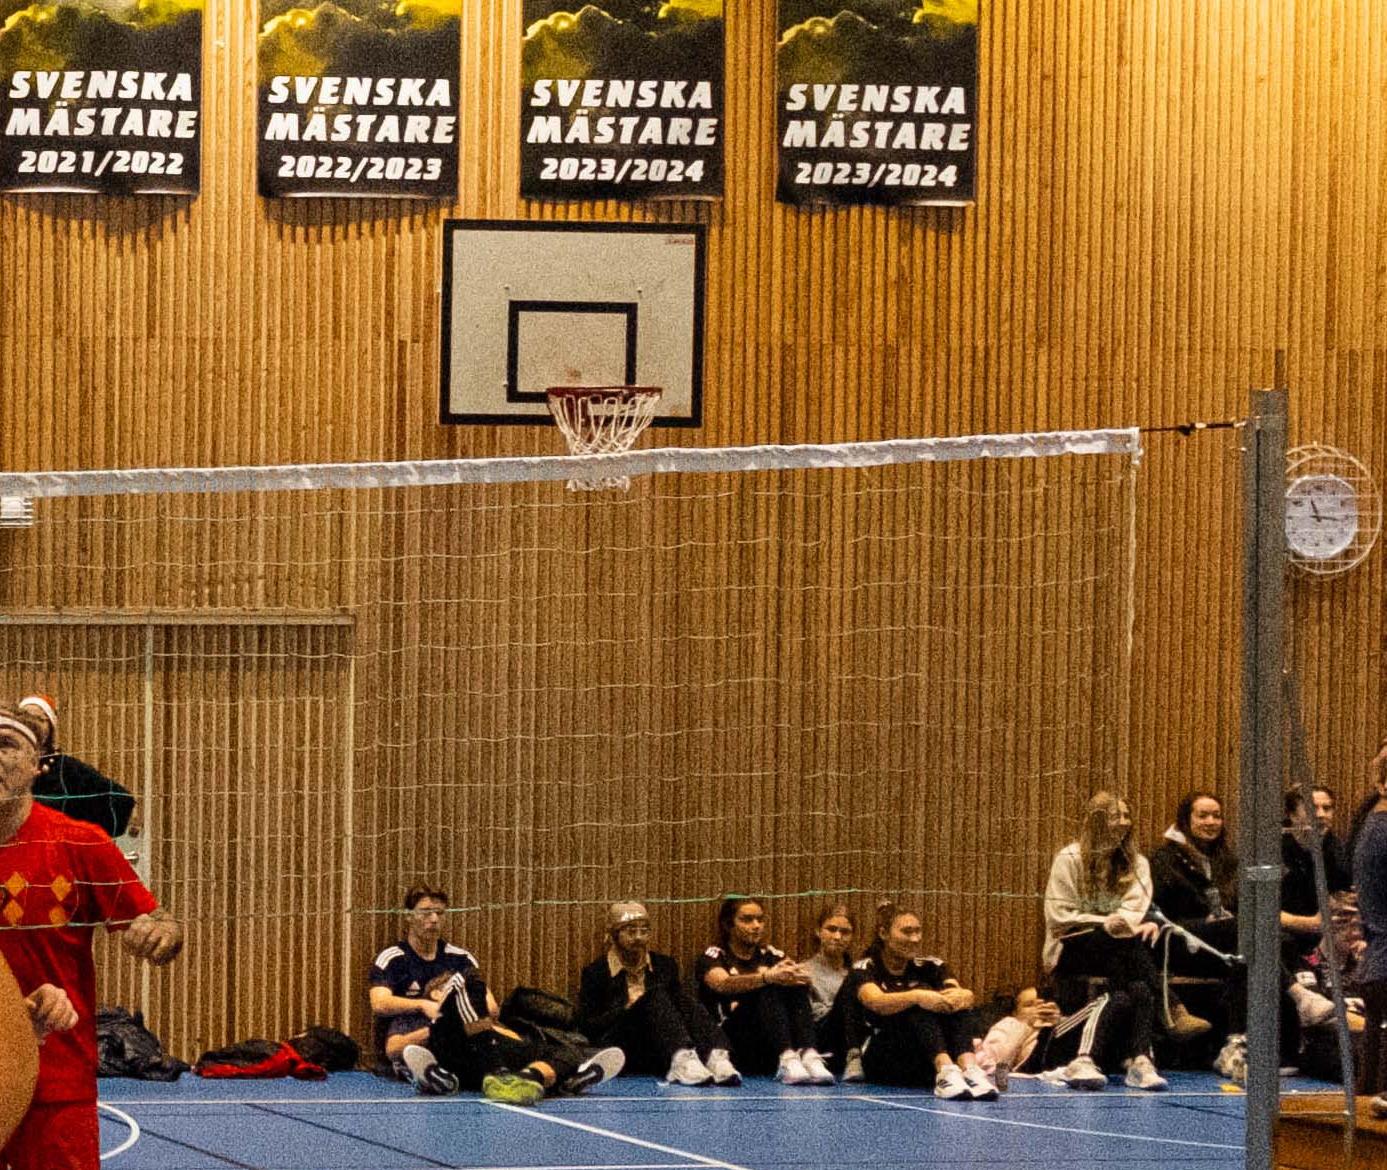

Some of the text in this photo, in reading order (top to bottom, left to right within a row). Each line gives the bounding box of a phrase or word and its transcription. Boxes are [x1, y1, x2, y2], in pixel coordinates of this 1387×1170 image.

[9, 70, 193, 102] SVENSKA
[267, 75, 451, 107] SVENSKA
[530, 79, 713, 109] SVENSKA
[785, 83, 966, 115] SVENSKA
[5, 100, 198, 139] MÄSTARE
[264, 105, 457, 144] MÄSTARE
[526, 108, 718, 146] MÄSTARE
[782, 113, 971, 151] MÄSTARE
[17, 150, 184, 177] 2021/2022
[277, 155, 442, 183] 2022/2023
[539, 157, 704, 184] 2023/2024
[795, 162, 957, 187] 2023/2024
